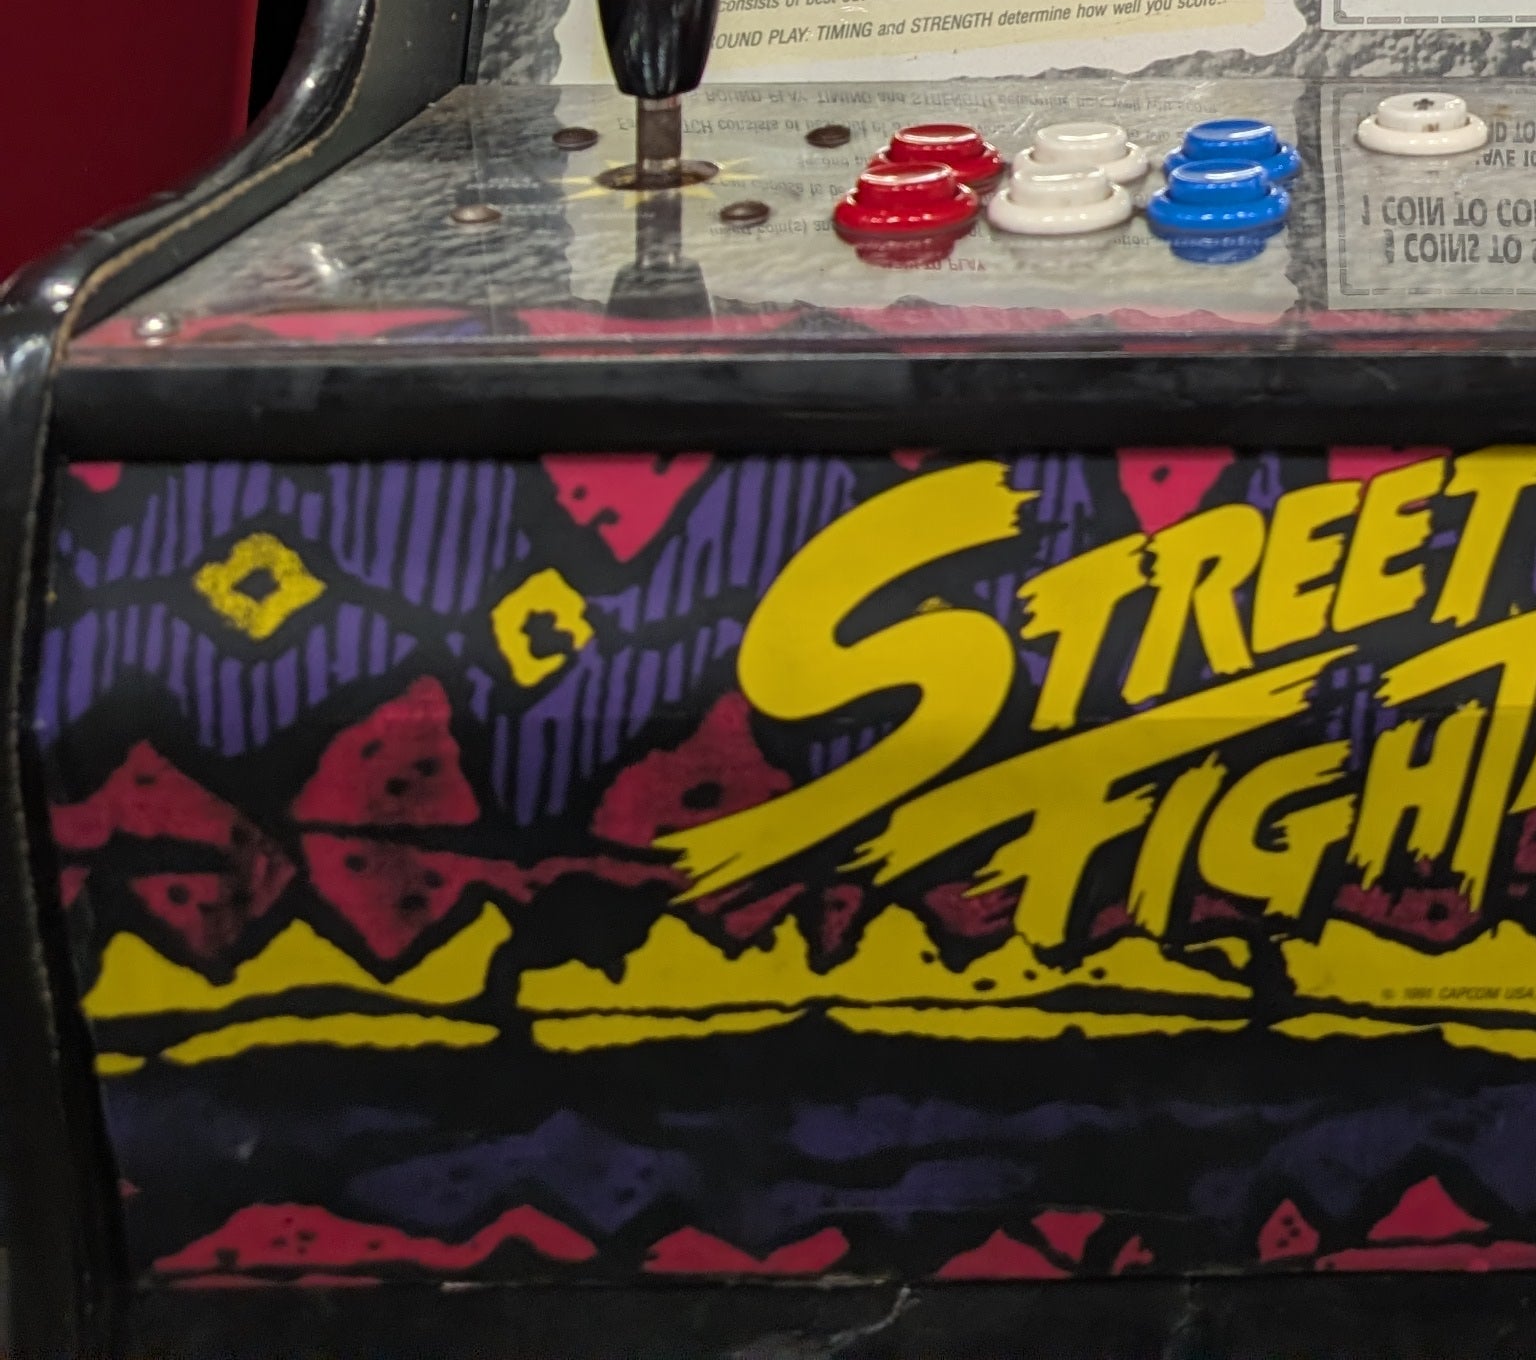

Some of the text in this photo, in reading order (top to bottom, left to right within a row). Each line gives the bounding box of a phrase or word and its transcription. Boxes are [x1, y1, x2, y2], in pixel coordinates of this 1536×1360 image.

[817, 21, 873, 41] TIMING
[877, 20, 906, 36] and
[910, 12, 994, 34] STRENGTH
[997, 5, 1072, 27] determine
[1076, 1, 1108, 19] how
